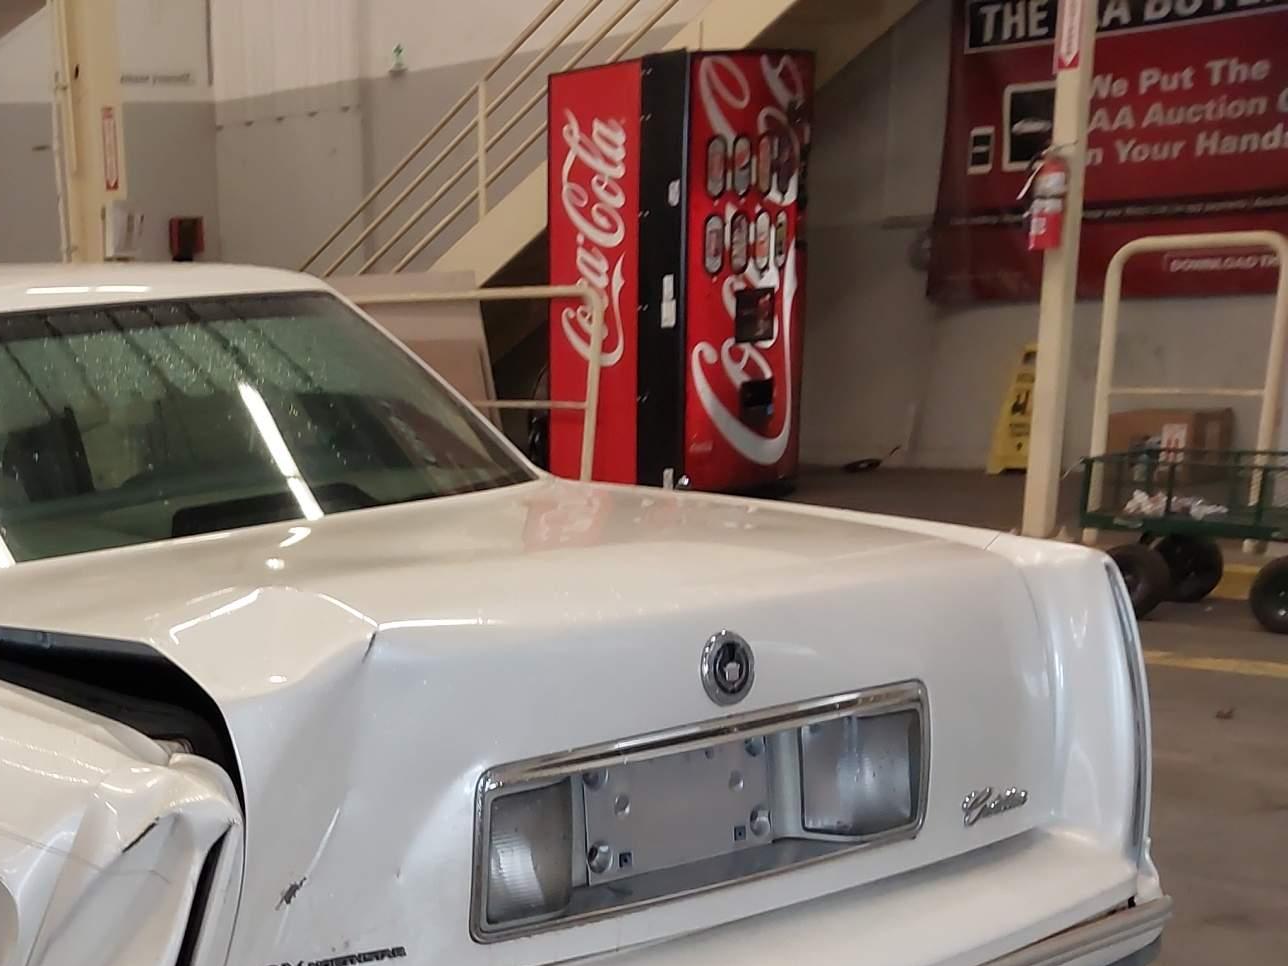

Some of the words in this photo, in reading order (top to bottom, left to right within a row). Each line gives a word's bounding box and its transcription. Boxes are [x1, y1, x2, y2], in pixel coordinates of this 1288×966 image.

[978, 0, 1050, 44] THE
[1090, 73, 1129, 99] We
[1139, 66, 1195, 95] Put
[1204, 57, 1272, 87] The
[1088, 105, 1136, 134] AA
[1141, 94, 1269, 129] Auction
[1085, 147, 1104, 167] n
[1114, 137, 1187, 163] Your
